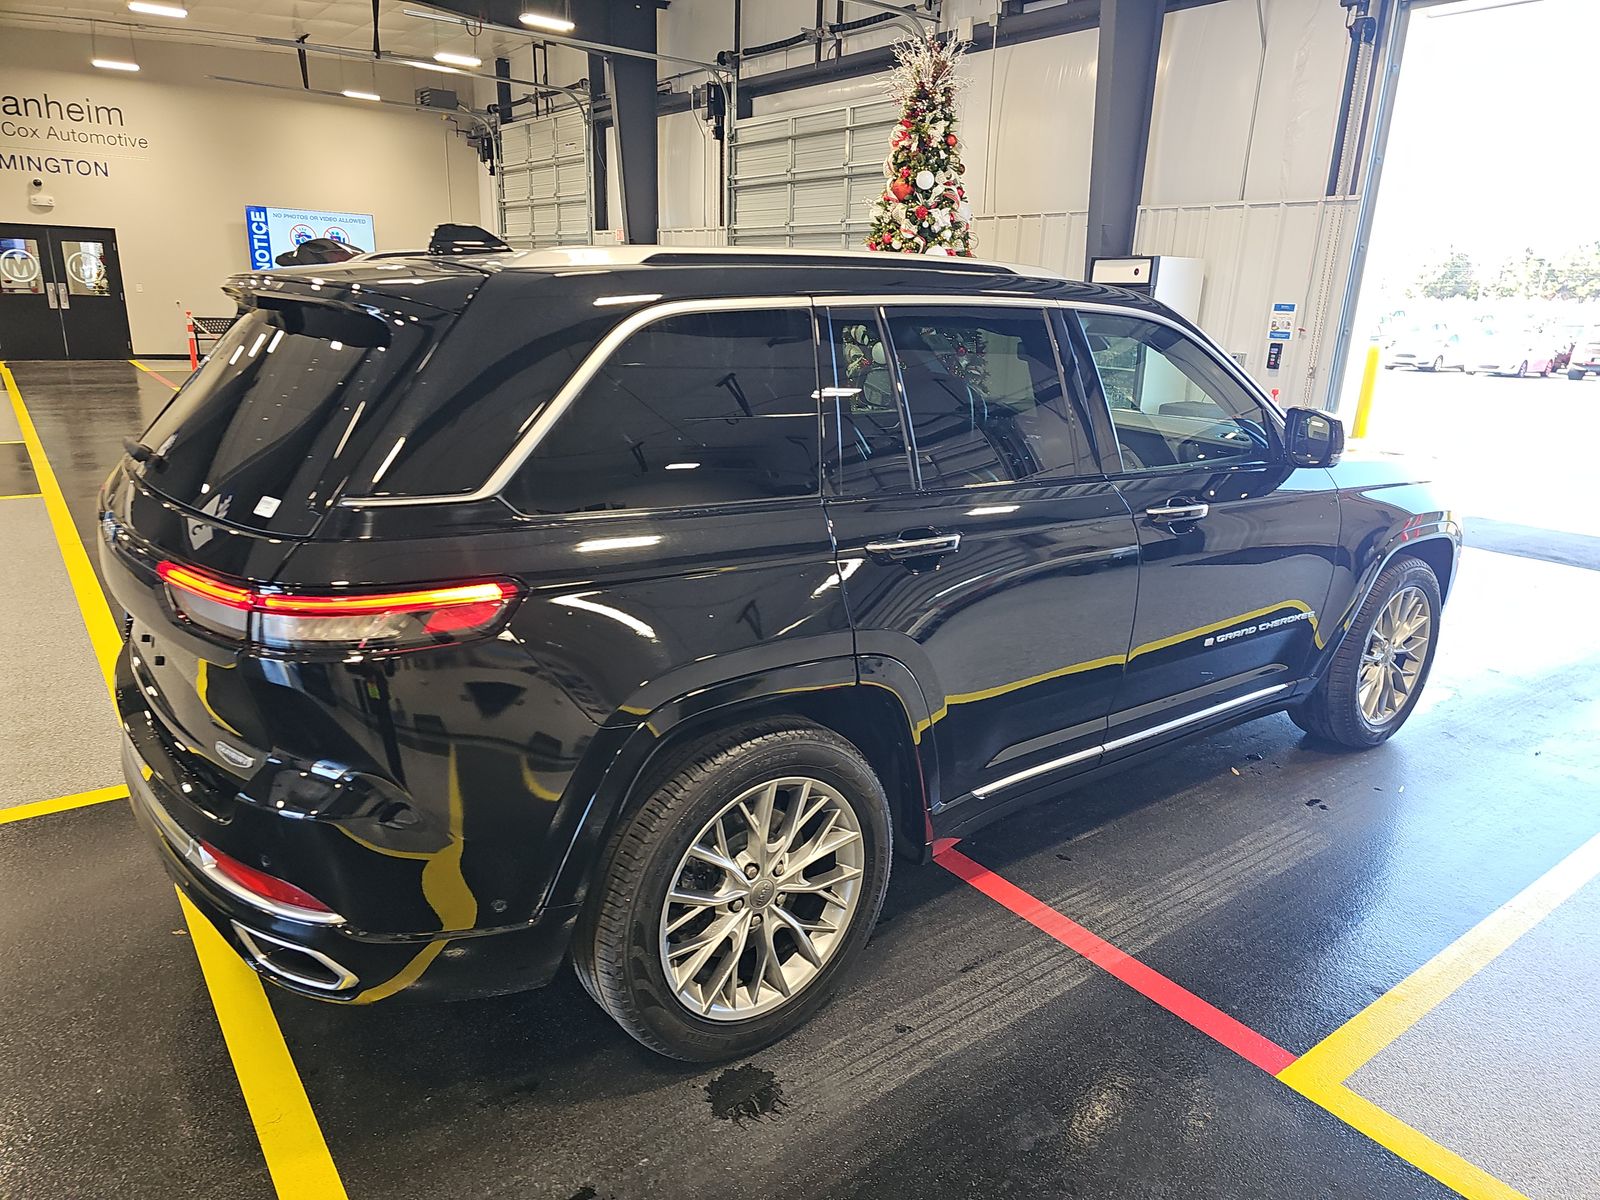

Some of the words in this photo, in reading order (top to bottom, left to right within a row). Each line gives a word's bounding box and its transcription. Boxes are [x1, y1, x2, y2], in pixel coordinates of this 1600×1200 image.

[2, 93, 124, 126] anheim
[1, 121, 40, 138] Cox
[46, 126, 149, 149] Automotive
[0, 153, 109, 177] MINGTON
[283, 213, 309, 221] PHOTOS
[319, 215, 338, 223] VIDEO
[338, 217, 367, 225] ALLOWED
[250, 210, 272, 270] NOTICE
[1216, 626, 1257, 643] GRAND
[1258, 610, 1316, 631] CHEROKEE
